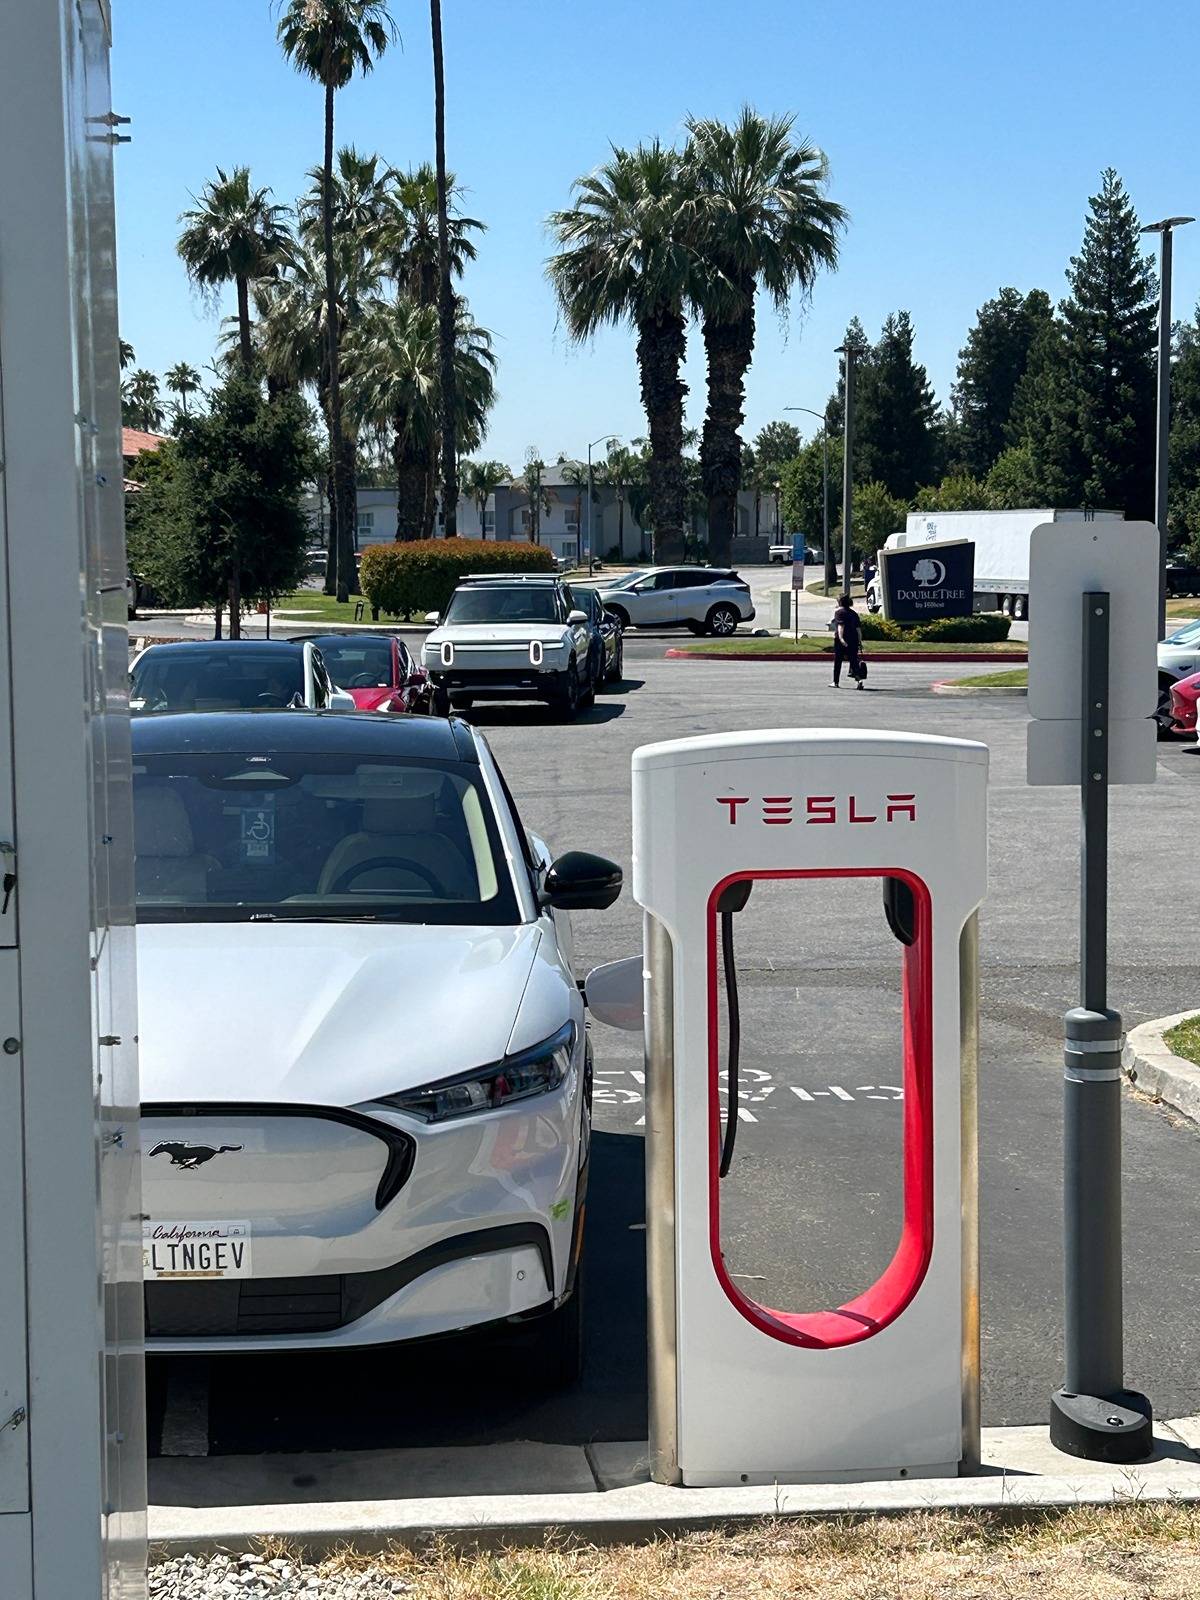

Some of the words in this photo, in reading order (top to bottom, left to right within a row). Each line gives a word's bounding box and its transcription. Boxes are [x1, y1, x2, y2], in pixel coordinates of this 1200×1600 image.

[716, 794, 915, 825] TESLA
[152, 1225, 228, 1244] California
[152, 1242, 244, 1270] LTNGEV
